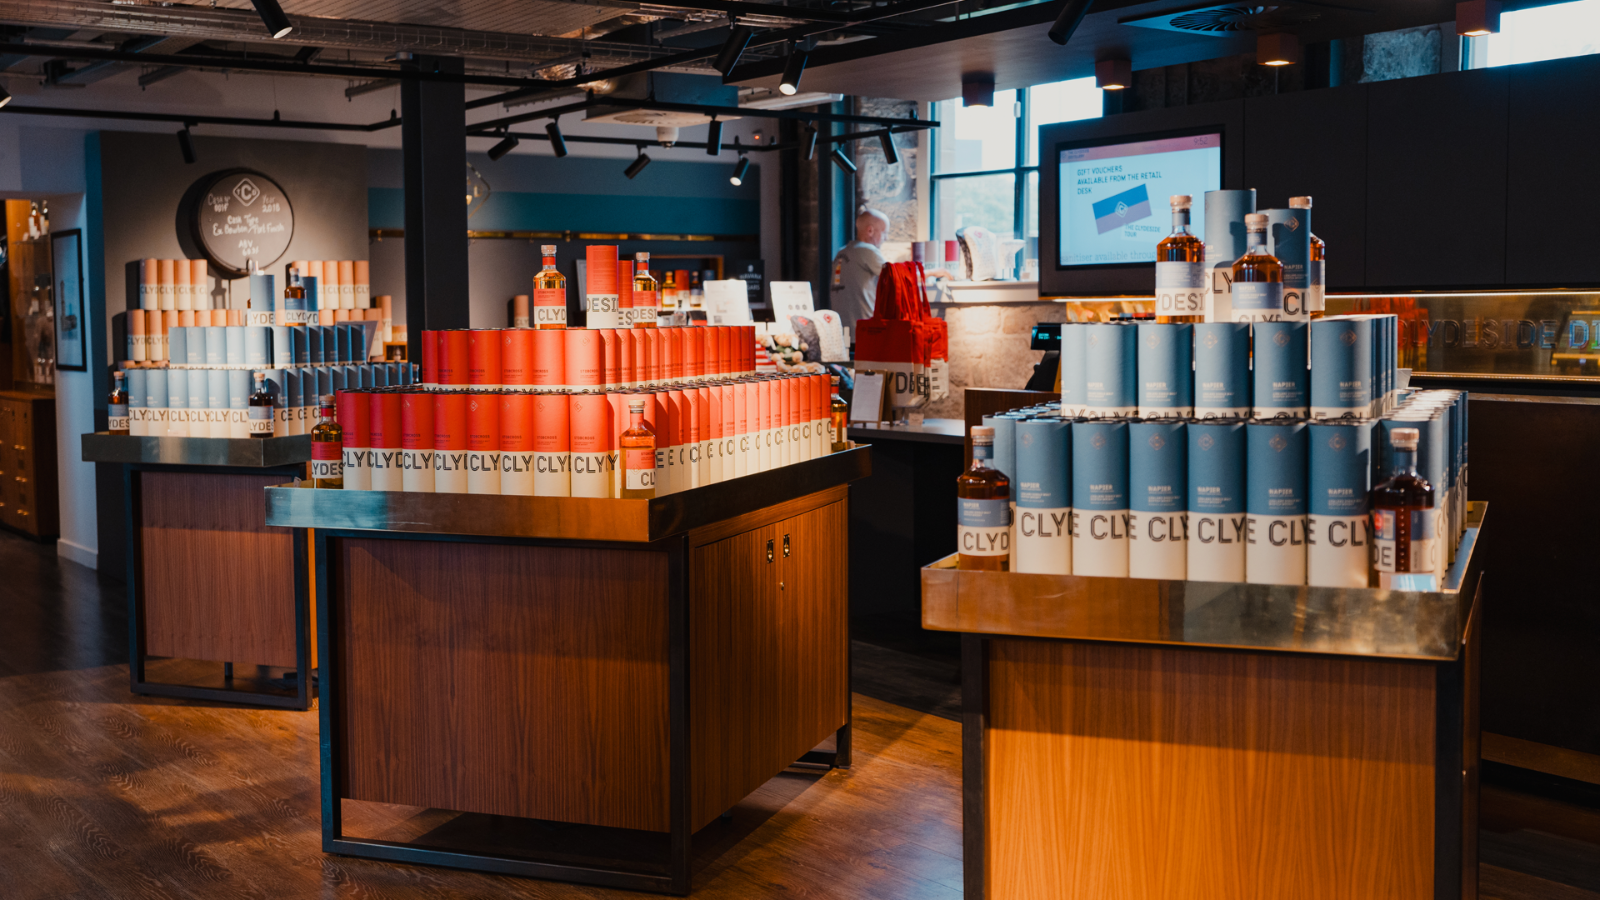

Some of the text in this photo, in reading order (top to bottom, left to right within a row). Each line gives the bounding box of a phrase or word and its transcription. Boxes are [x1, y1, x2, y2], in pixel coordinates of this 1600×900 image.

[1077, 165, 1122, 176] GIFT VOUCHERS
[1077, 171, 1162, 185] AVAILABLE FROM THE RETAIL
[1077, 187, 1092, 195] DESK
[1135, 225, 1161, 233] CLYDESIDE
[1061, 253, 1092, 263] sanitiser
[1094, 251, 1128, 262] available
